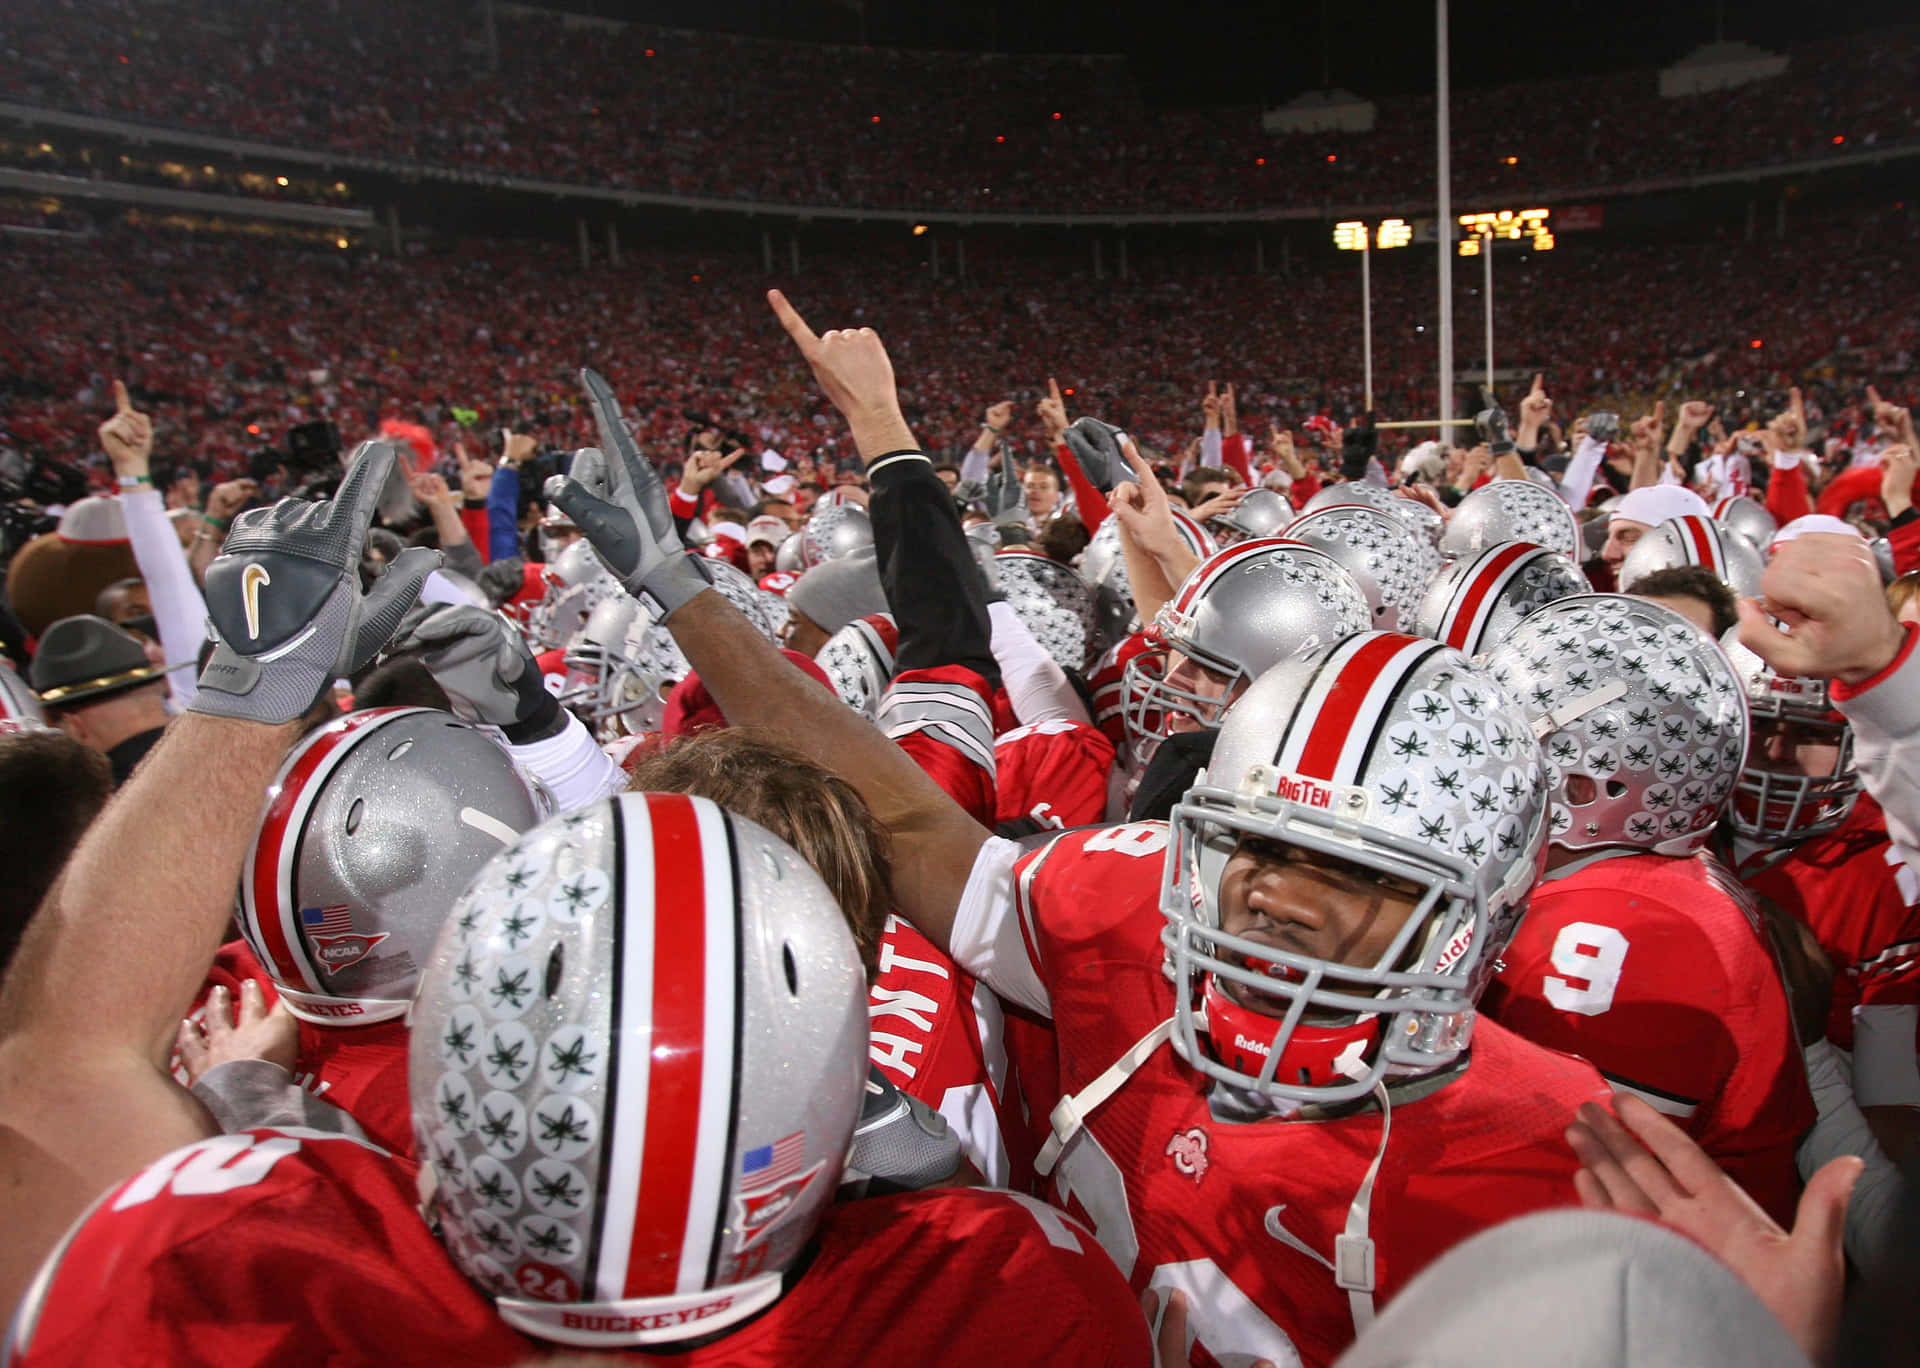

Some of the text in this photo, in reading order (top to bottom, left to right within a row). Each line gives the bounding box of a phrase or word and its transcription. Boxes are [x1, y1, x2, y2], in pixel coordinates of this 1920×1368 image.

[1542, 921, 1630, 1016] 9
[1234, 1033, 1272, 1057] Ridde
[523, 1267, 569, 1303] 24
[560, 1295, 736, 1333] BUCKEYES
